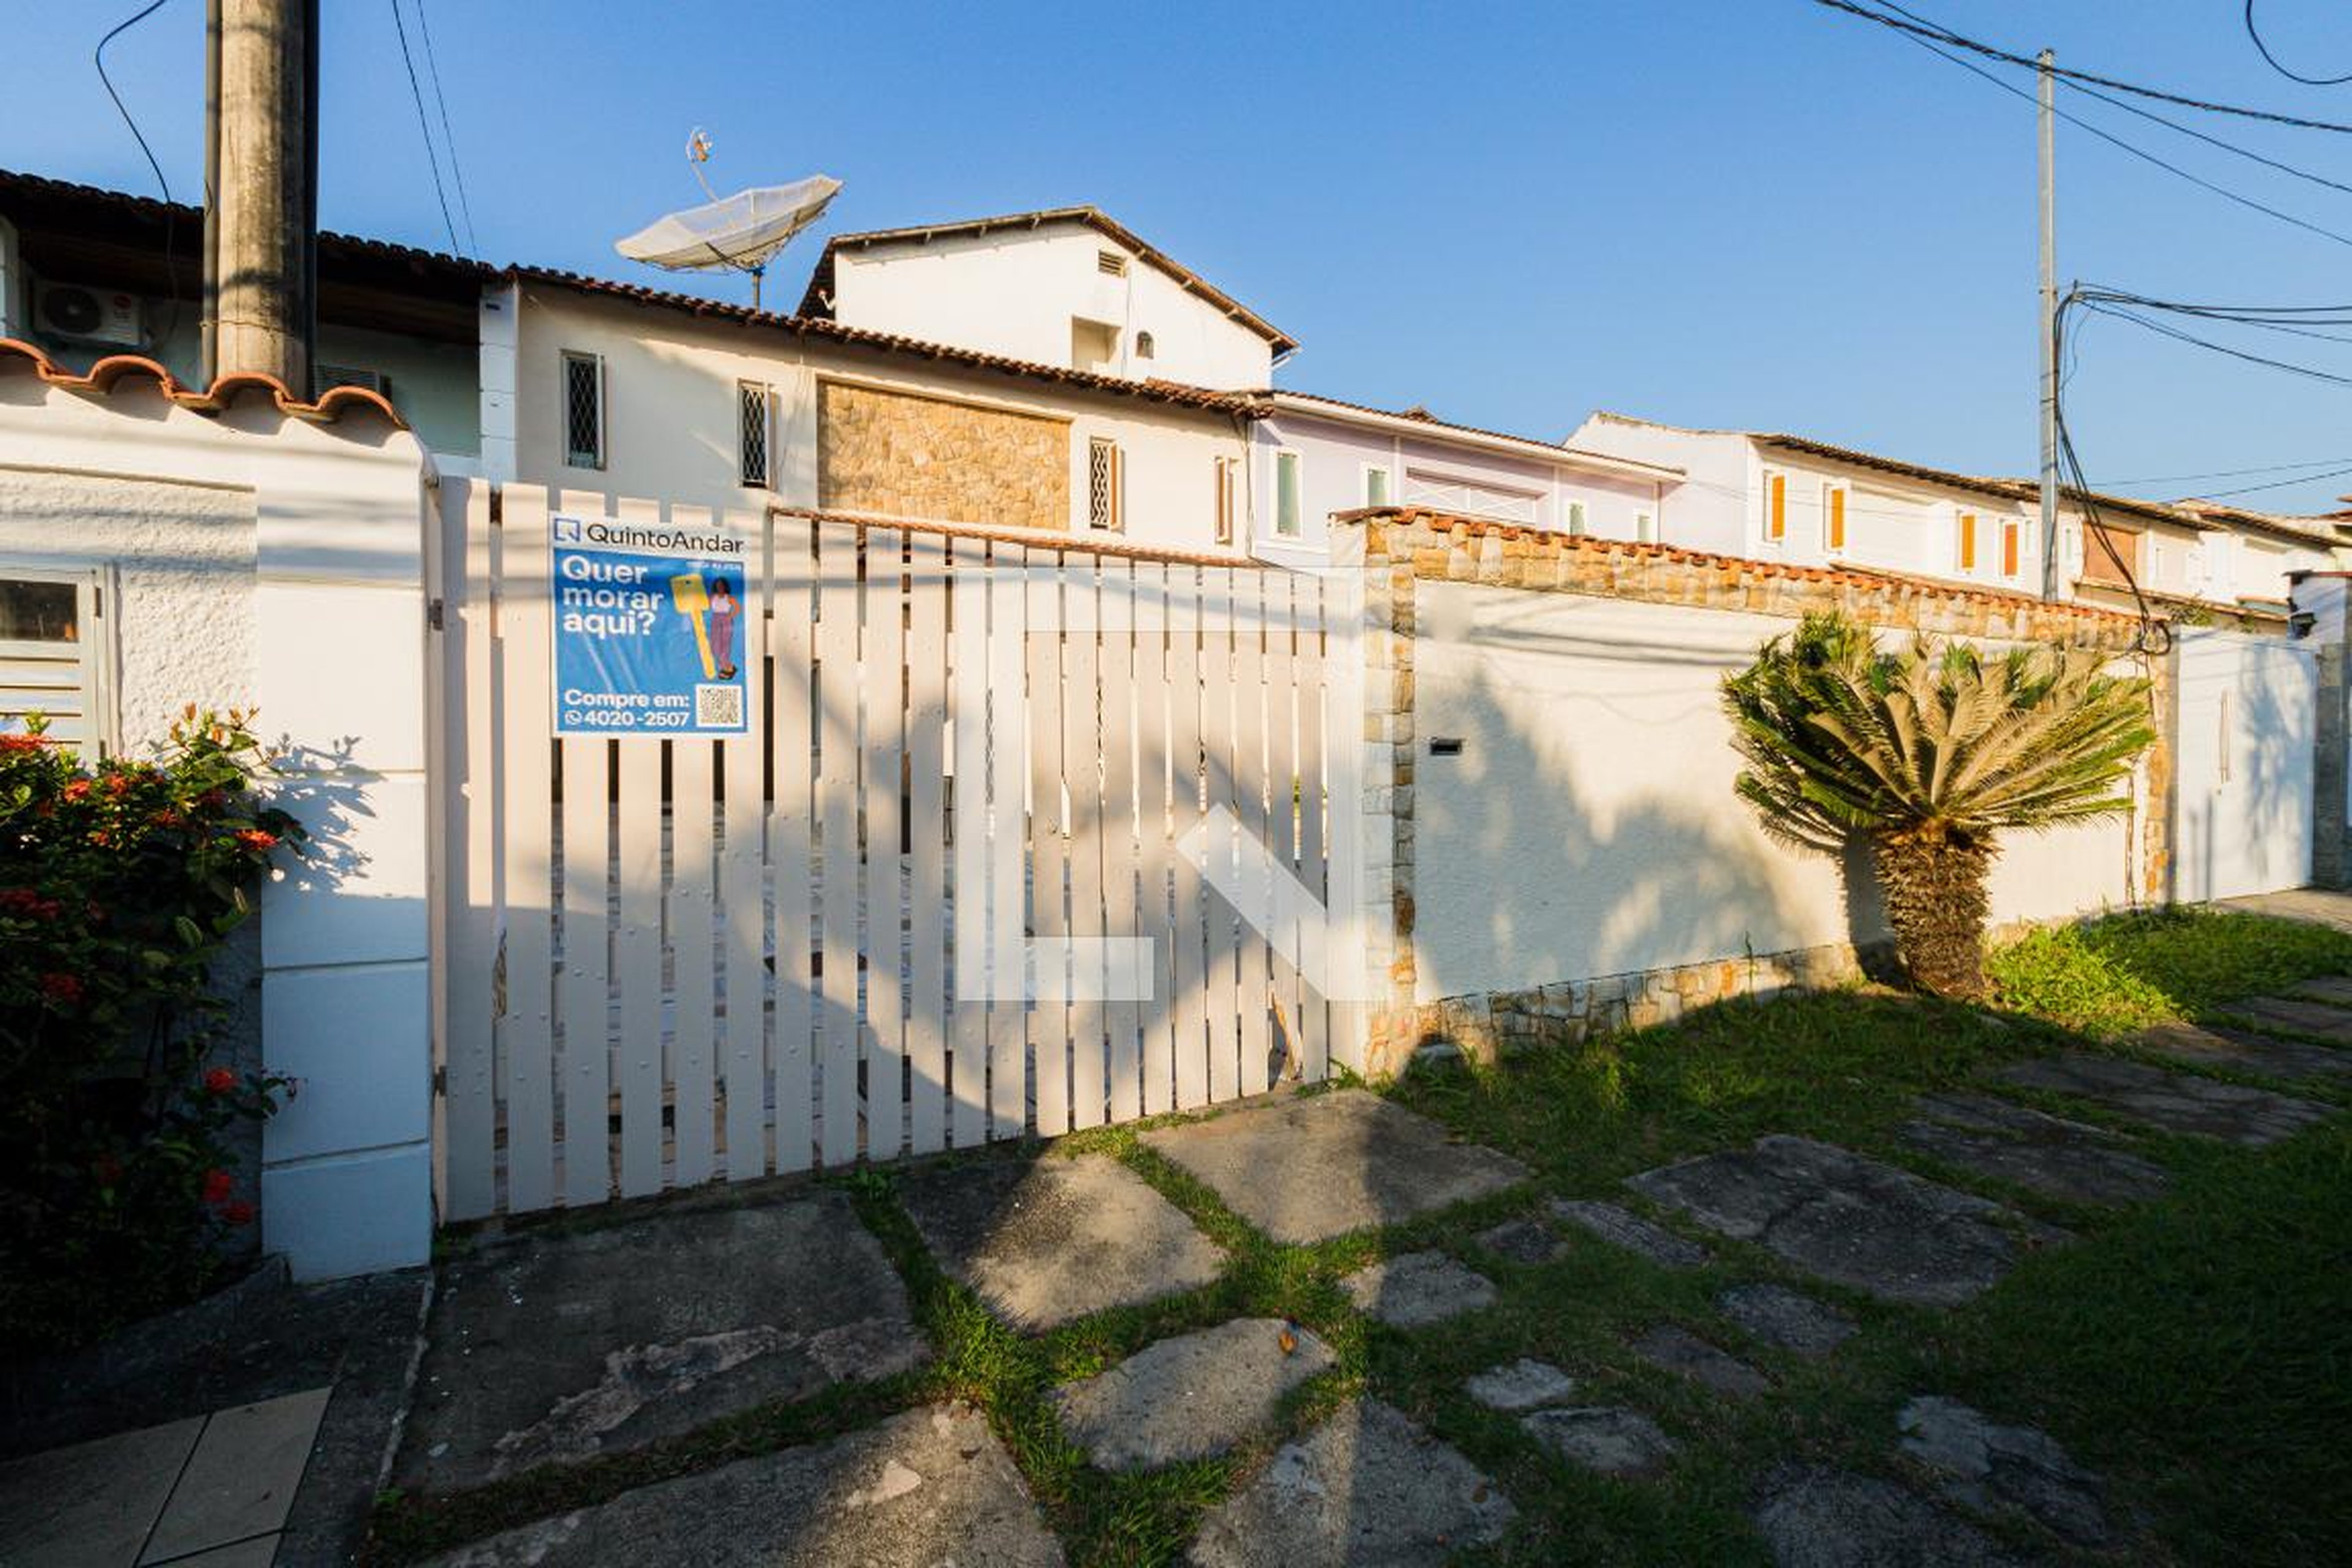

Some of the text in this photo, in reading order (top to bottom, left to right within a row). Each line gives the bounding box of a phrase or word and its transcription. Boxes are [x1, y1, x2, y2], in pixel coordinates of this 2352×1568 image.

[587, 523, 744, 552] QuintoAndar
[562, 554, 649, 584] Quer
[563, 587, 664, 611] morar
[563, 610, 656, 640] aqui?
[565, 688, 690, 709] Compre em:
[584, 710, 690, 726] 4020-2507
